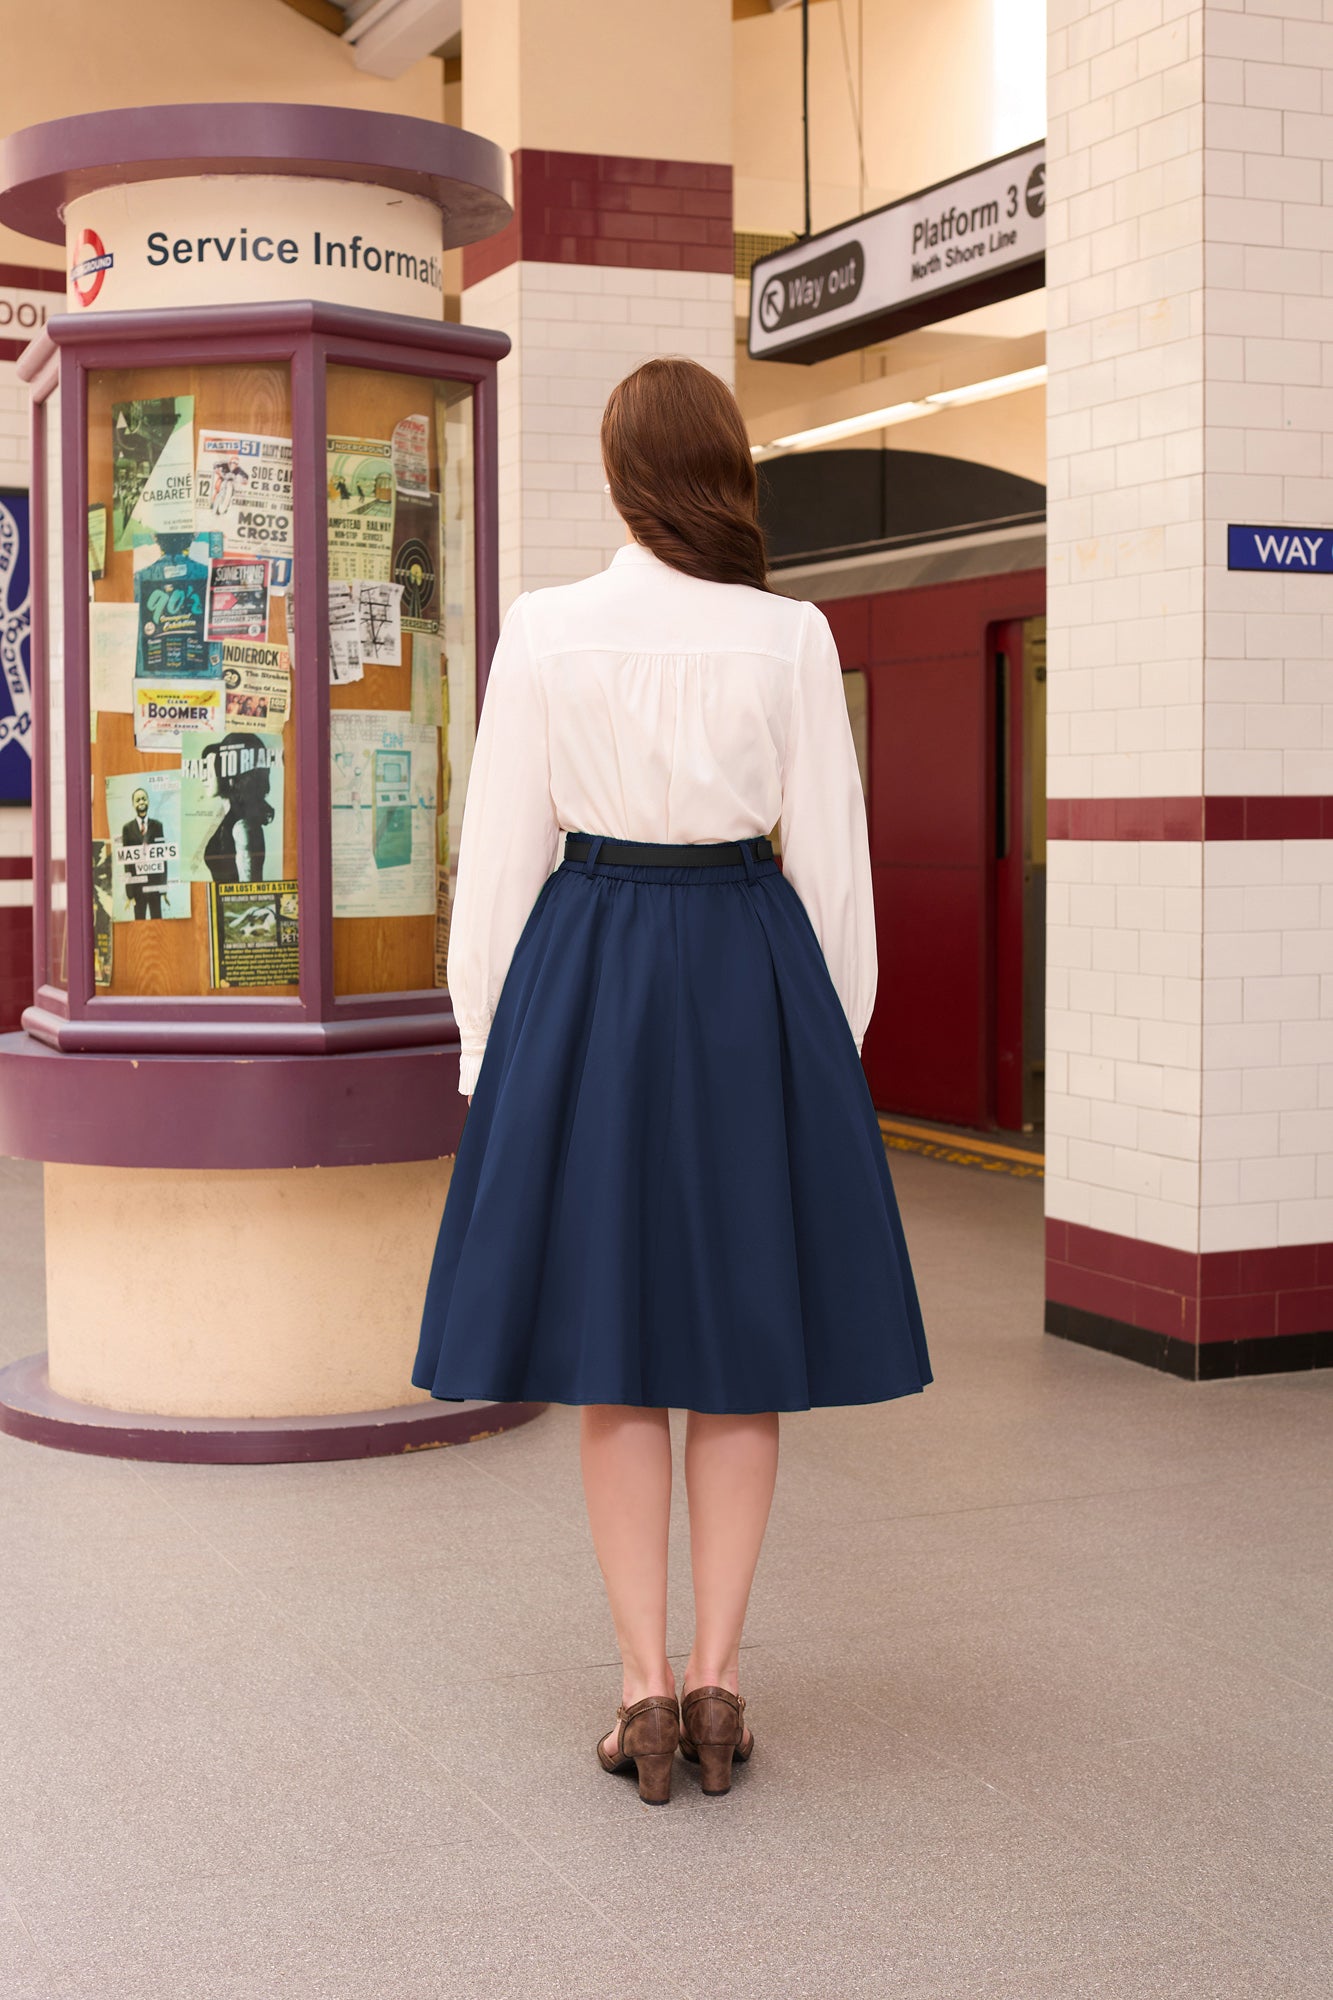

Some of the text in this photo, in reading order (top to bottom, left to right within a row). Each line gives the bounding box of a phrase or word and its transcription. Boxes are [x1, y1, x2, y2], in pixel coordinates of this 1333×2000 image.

[912, 185, 1018, 255] Platform 3
[147, 228, 442, 292] Service Informati
[911, 230, 1017, 282] North Shore Line
[788, 257, 856, 310] Way out
[207, 441, 239, 449] PASTIS
[241, 440, 257, 455] 51
[166, 473, 192, 489] CINÉ
[251, 466, 274, 481] SIDE
[142, 487, 192, 502] CABARET
[199, 480, 210, 497] 12
[238, 511, 289, 530] MOTO
[237, 526, 288, 542] CROSS
[1253, 534, 1324, 566] WAY
[215, 564, 265, 582] SOMETHING
[222, 645, 279, 667] INDIEROCK
[148, 702, 208, 719] BOOMER
[220, 750, 238, 777] TO
[136, 862, 162, 872] VOICE
